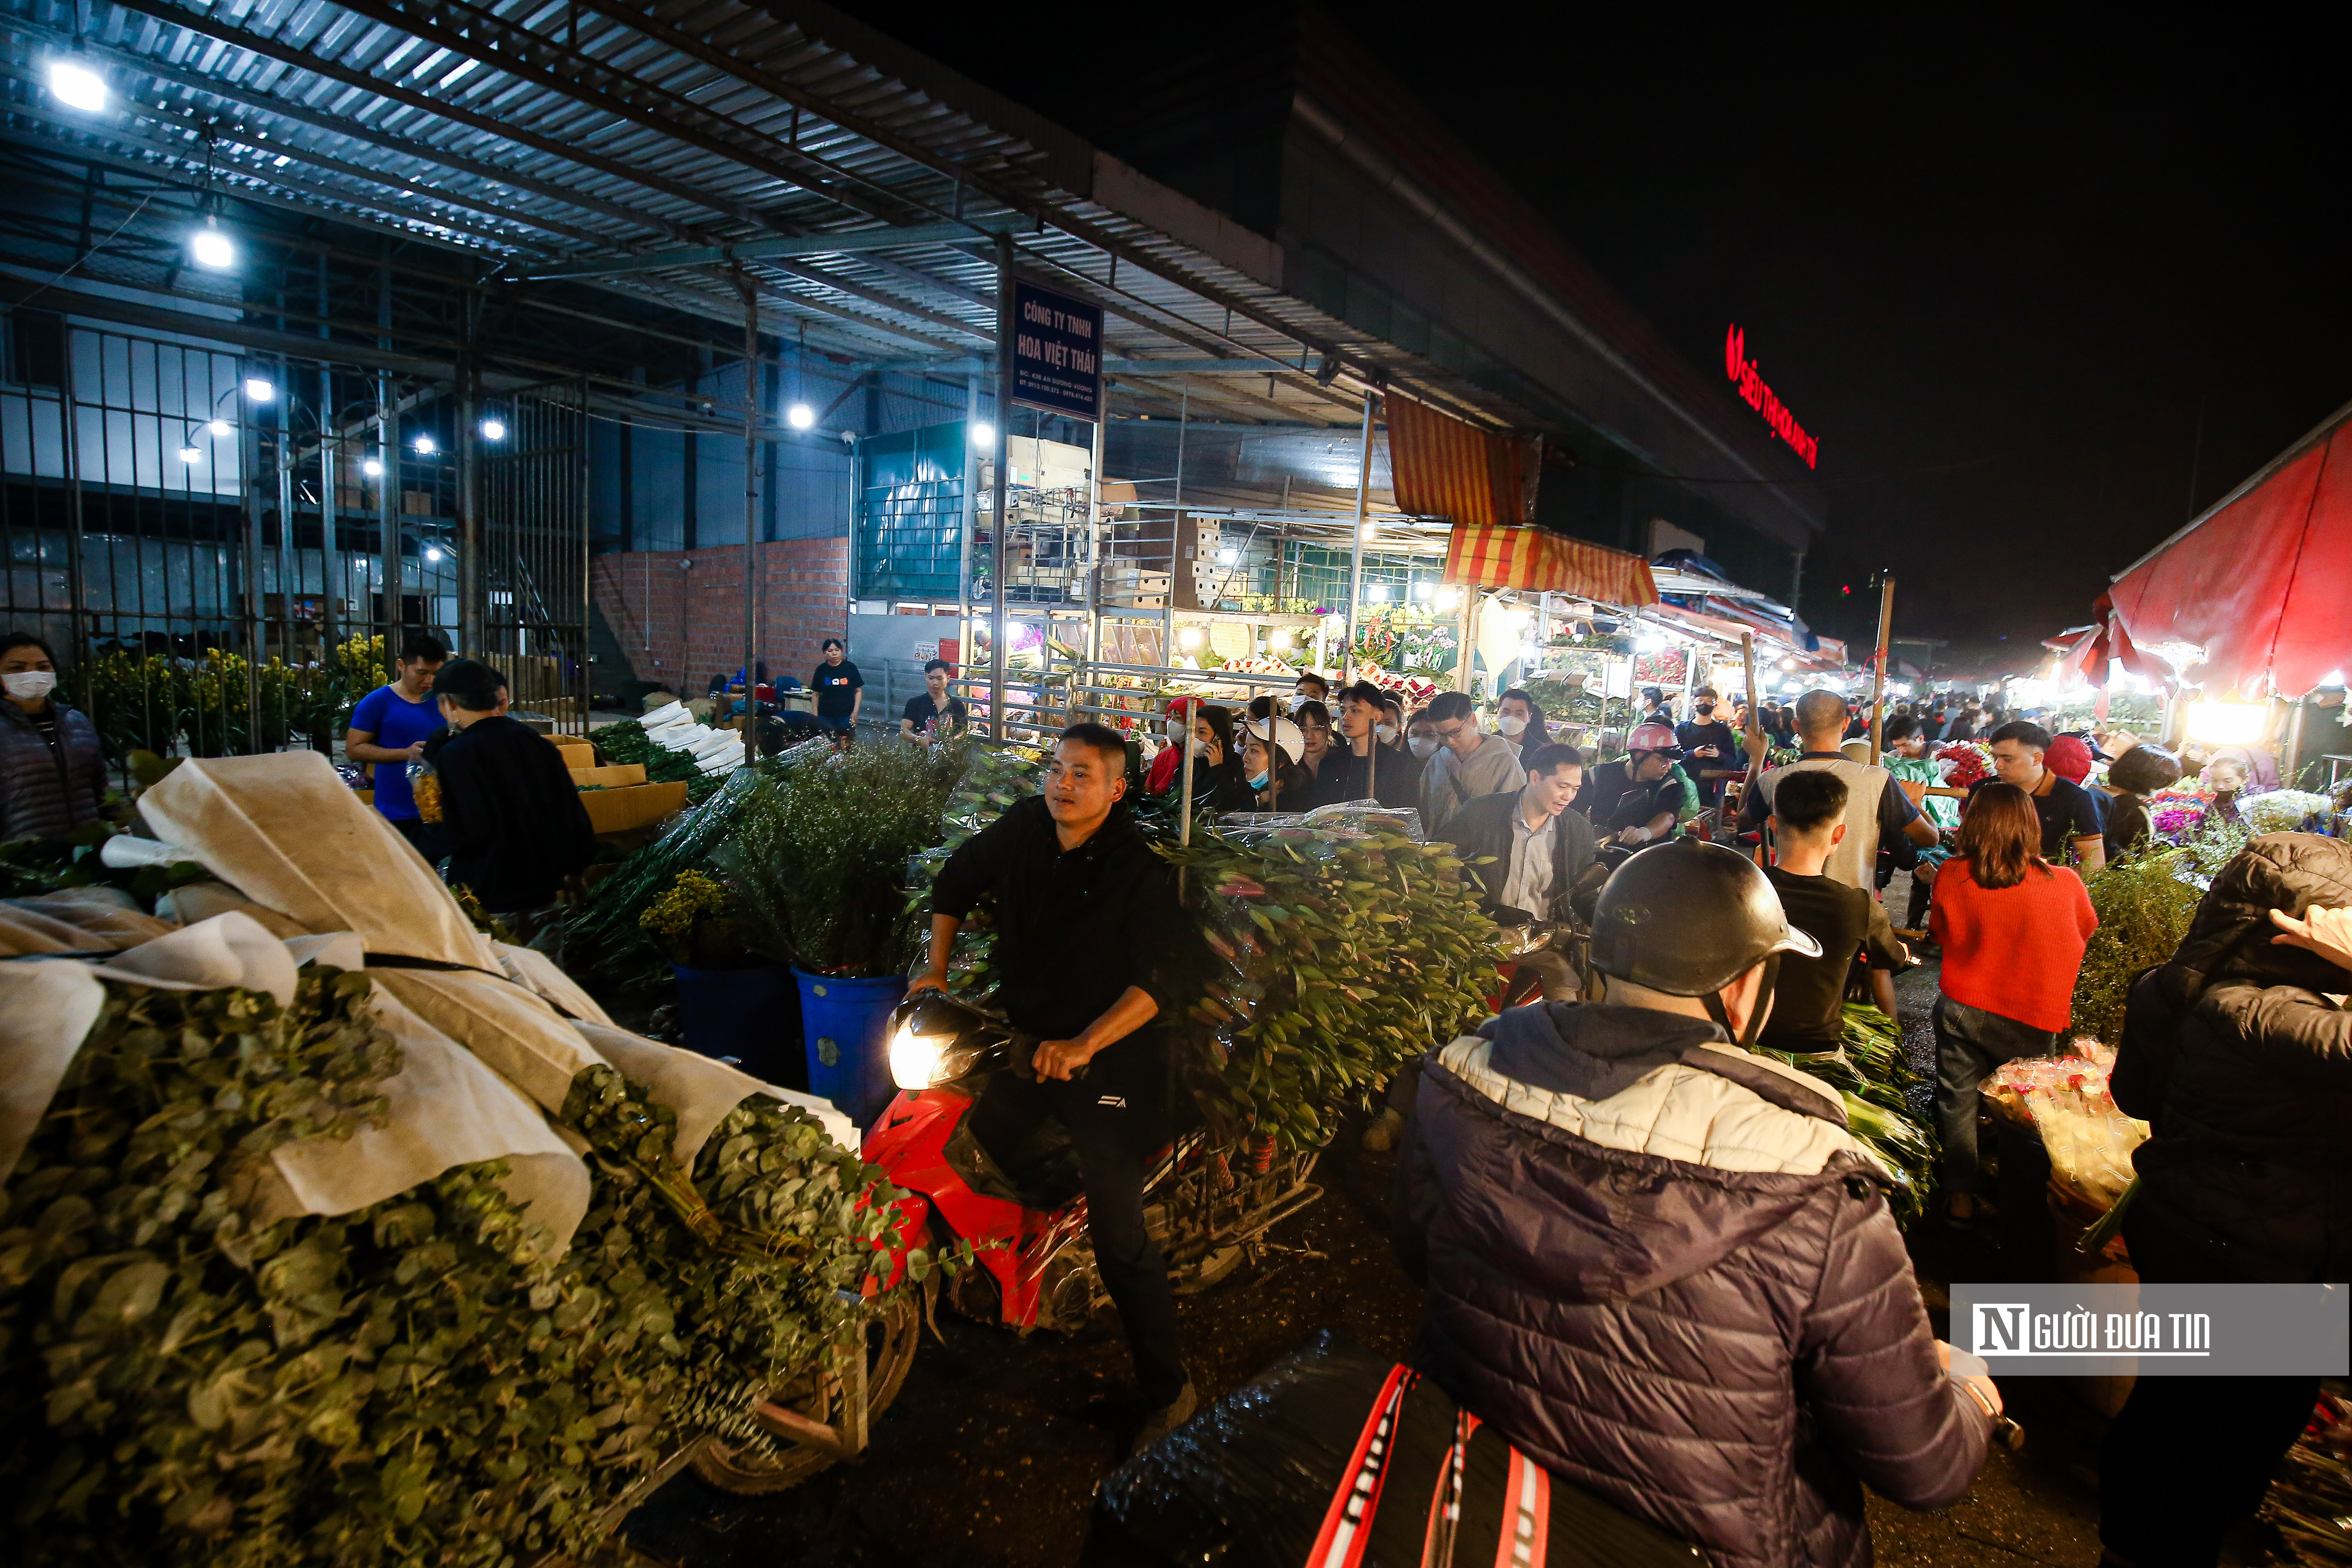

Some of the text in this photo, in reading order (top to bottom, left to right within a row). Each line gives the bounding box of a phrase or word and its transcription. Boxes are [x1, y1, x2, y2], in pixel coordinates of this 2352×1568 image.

[1025, 300, 1091, 338] CÔNG TY TNHH
[1018, 334, 1094, 374] HOA VIỆT THÁI
[1762, 385, 1778, 438] THỊ
